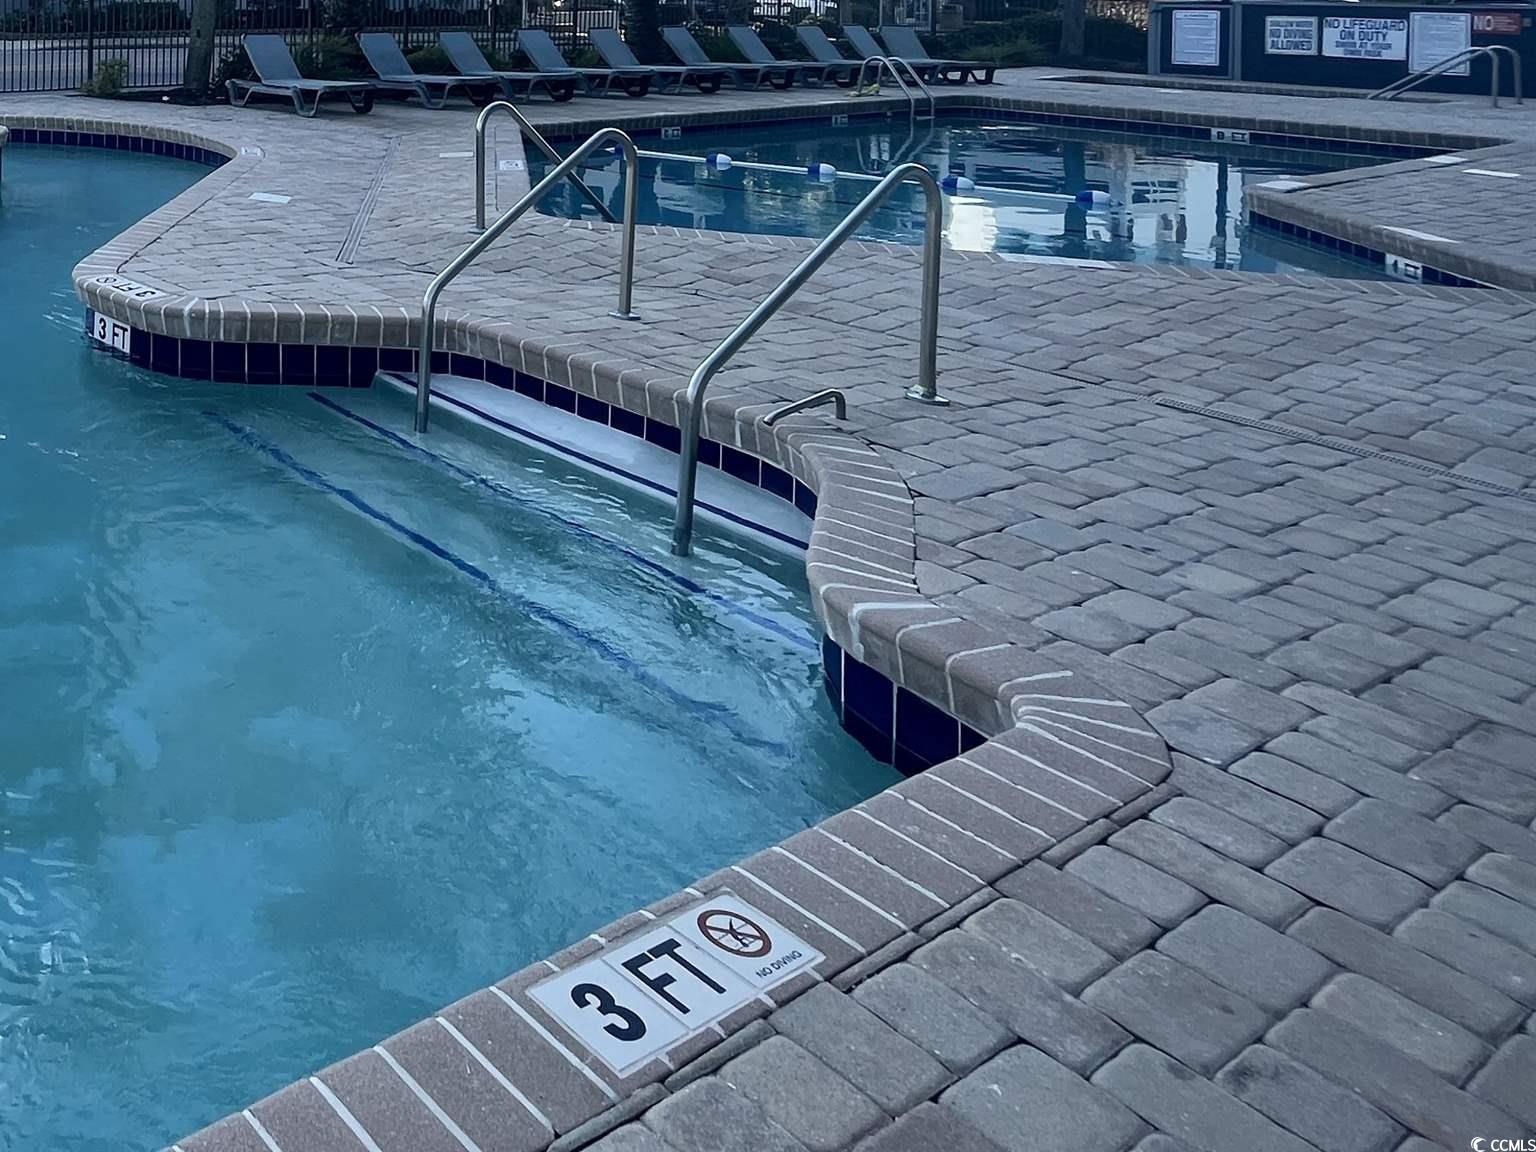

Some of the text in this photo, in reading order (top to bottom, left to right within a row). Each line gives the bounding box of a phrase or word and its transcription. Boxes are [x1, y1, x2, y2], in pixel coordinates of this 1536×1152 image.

[1325, 18, 1405, 31] NO LIFEGUARD
[1473, 15, 1494, 31] NO
[1339, 30, 1388, 42] ON DUTY
[1270, 39, 1313, 51] ALLOWED
[98, 317, 129, 350] 3 FT
[755, 949, 803, 978] NO DIVING
[570, 937, 727, 1042] 3 FT
